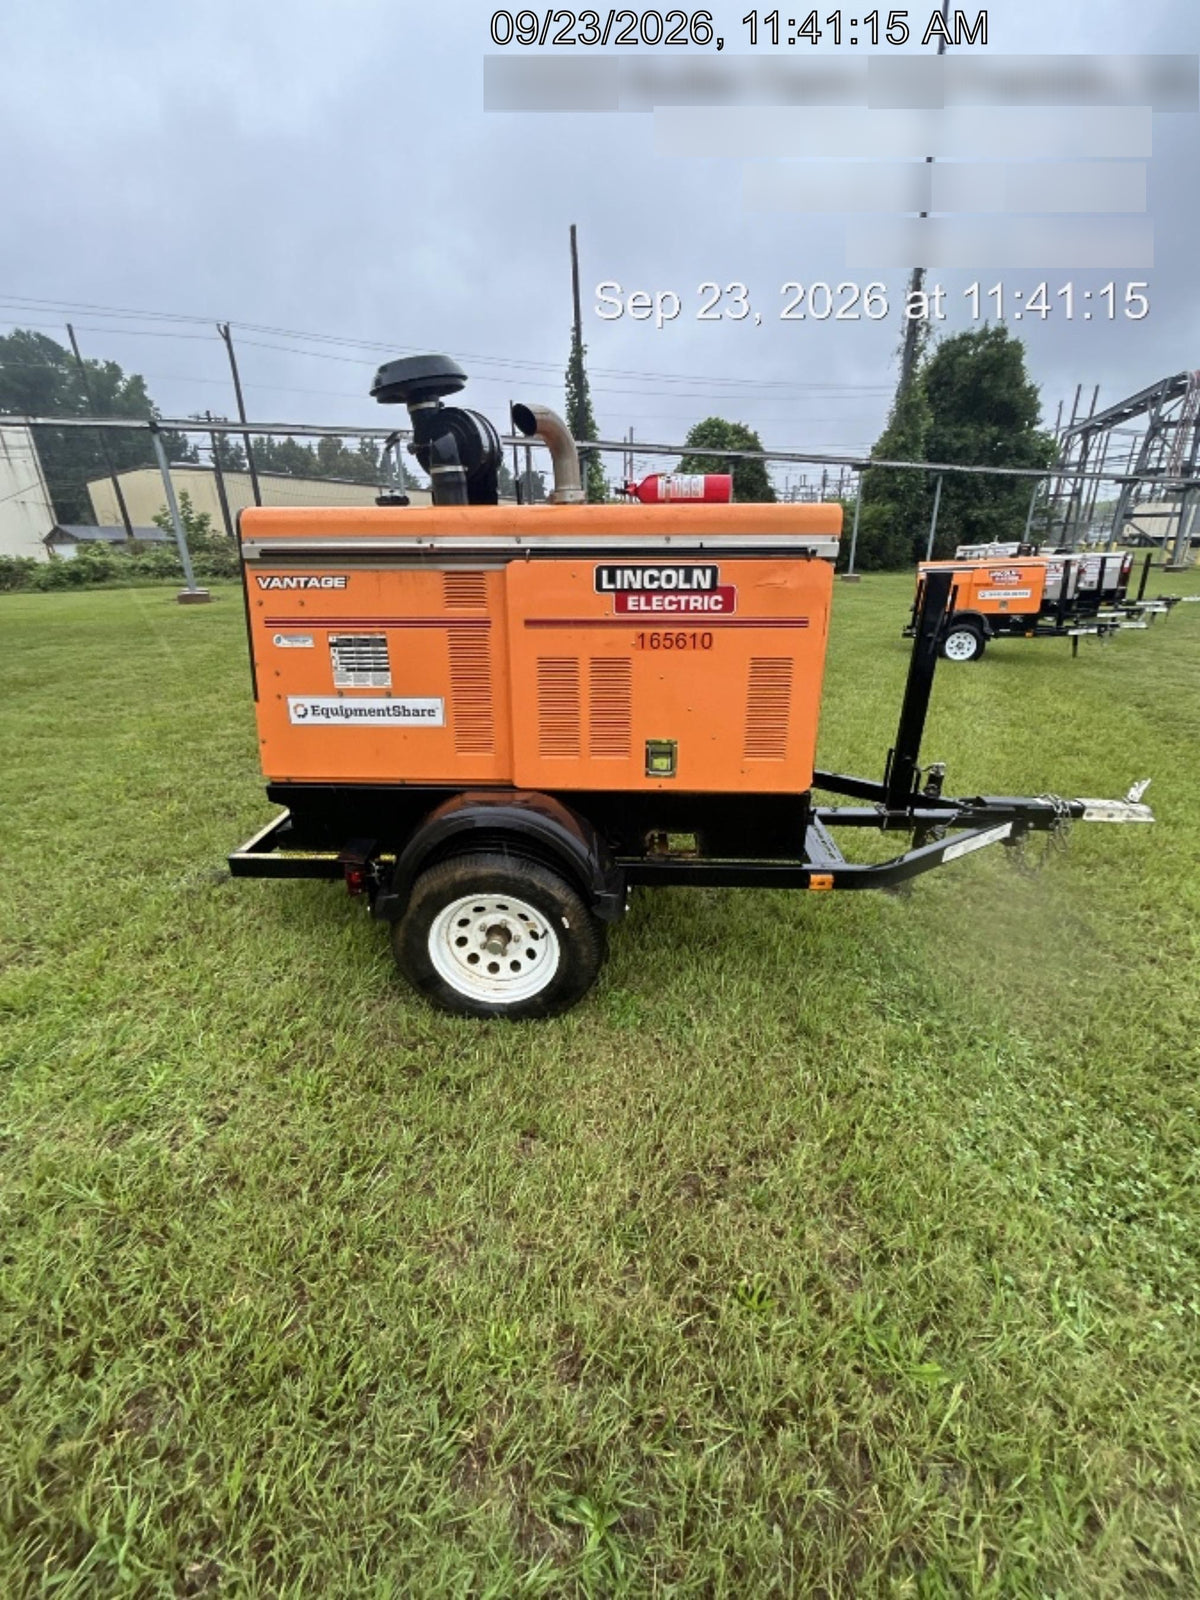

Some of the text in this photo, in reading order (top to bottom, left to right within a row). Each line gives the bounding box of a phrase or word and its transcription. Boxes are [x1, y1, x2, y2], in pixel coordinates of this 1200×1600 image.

[256, 575, 348, 590] VANTAGE
[601, 568, 713, 590] LINCOLN
[626, 595, 724, 611] ELECTRIC
[637, 632, 714, 650] 165610
[310, 704, 437, 720] EquipmentShare
